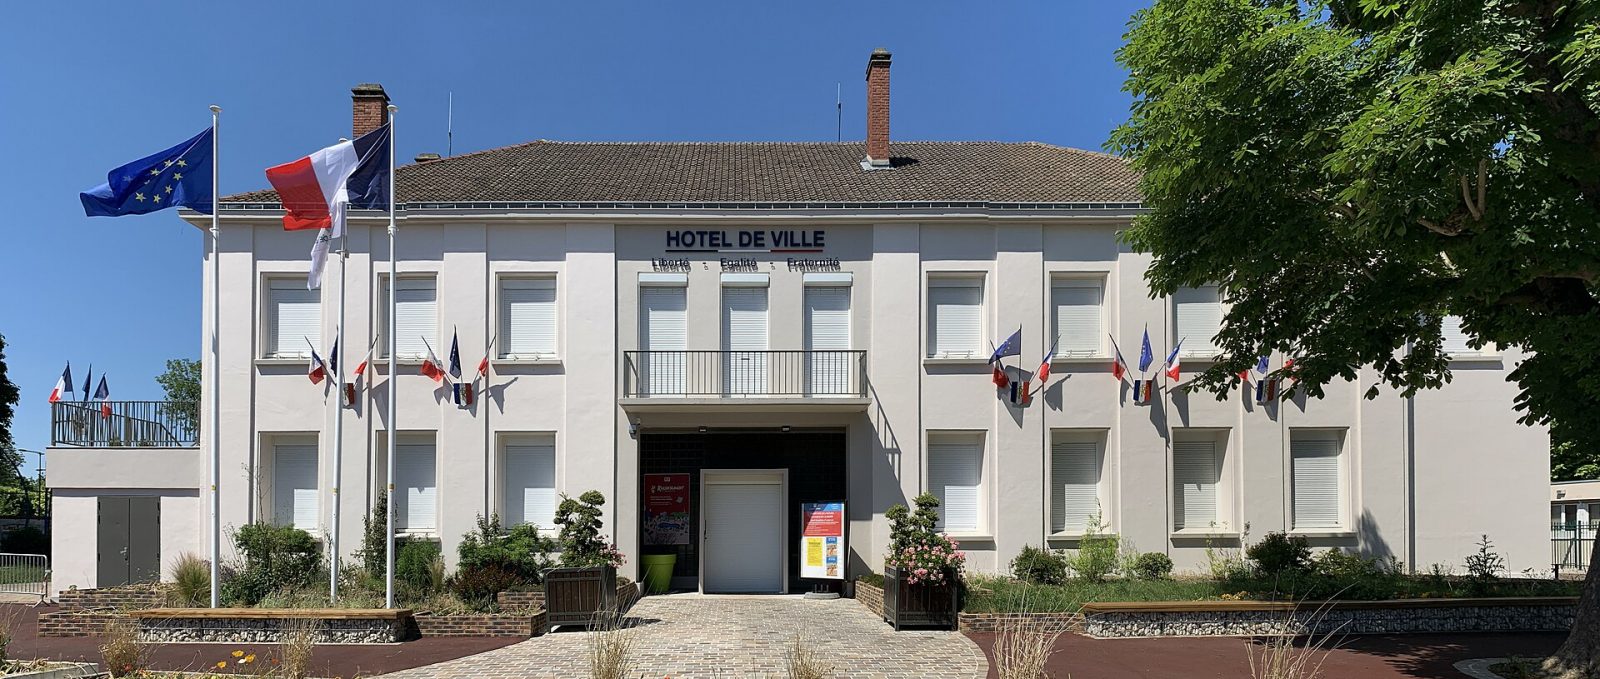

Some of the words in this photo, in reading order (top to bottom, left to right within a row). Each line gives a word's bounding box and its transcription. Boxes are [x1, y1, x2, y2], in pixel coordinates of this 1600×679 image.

[666, 231, 732, 247] HOTEL
[739, 231, 765, 247] DE
[771, 231, 825, 247] VILLE
[651, 257, 690, 267] Liberté
[720, 257, 757, 268] Egalité
[787, 257, 840, 267] Fraternité
